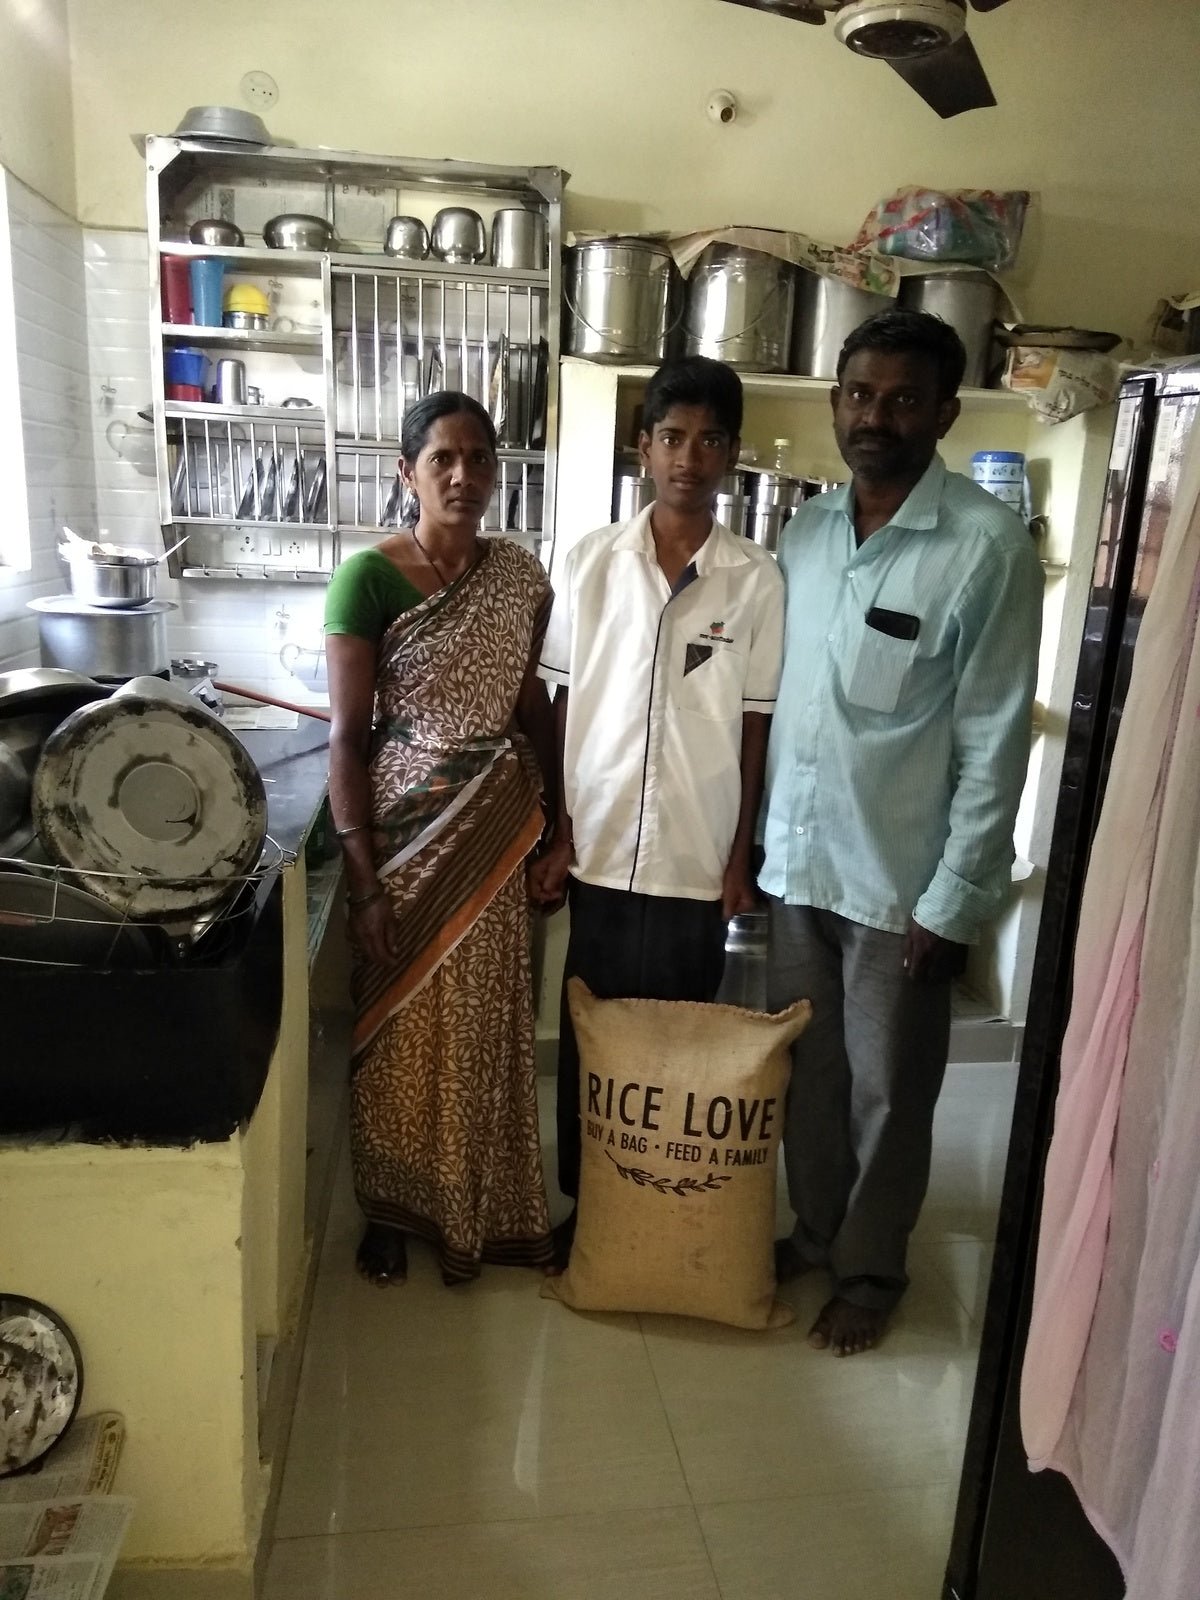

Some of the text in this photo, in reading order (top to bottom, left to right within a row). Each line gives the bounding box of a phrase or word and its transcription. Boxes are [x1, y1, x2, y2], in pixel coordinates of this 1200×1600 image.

[588, 1071, 776, 1141] RICE LOVE
[587, 1119, 769, 1166] BUY A BAG FEED A FAMILY
